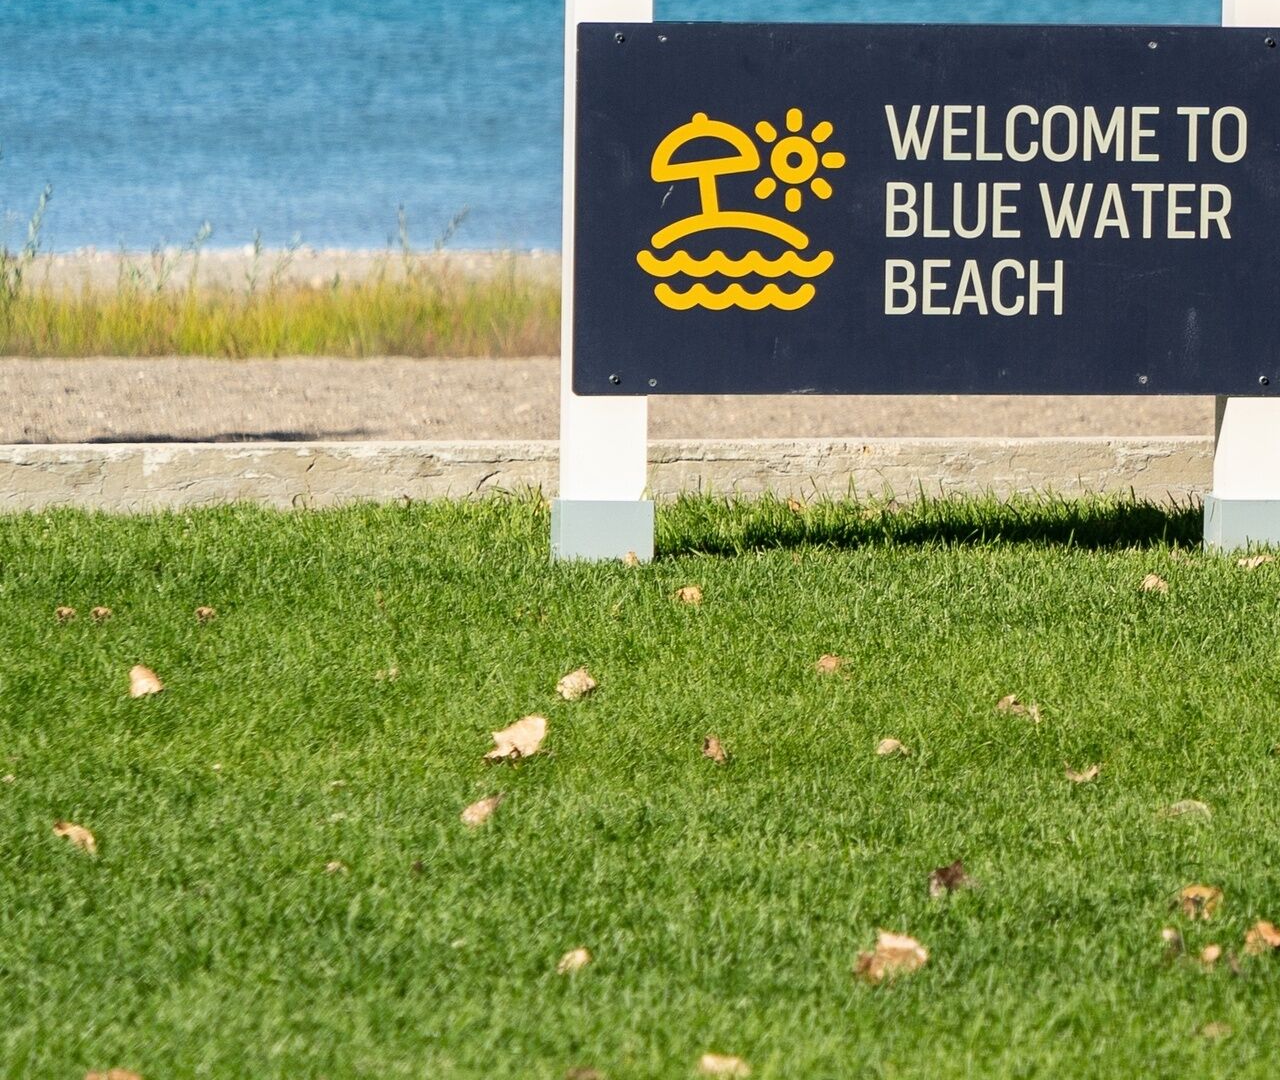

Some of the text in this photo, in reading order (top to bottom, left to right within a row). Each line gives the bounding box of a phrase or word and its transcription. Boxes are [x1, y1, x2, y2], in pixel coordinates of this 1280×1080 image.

[884, 104, 1248, 163] WELCOME TO
[885, 181, 1232, 240] BLUE WATER
[884, 258, 1064, 317] BEACH
